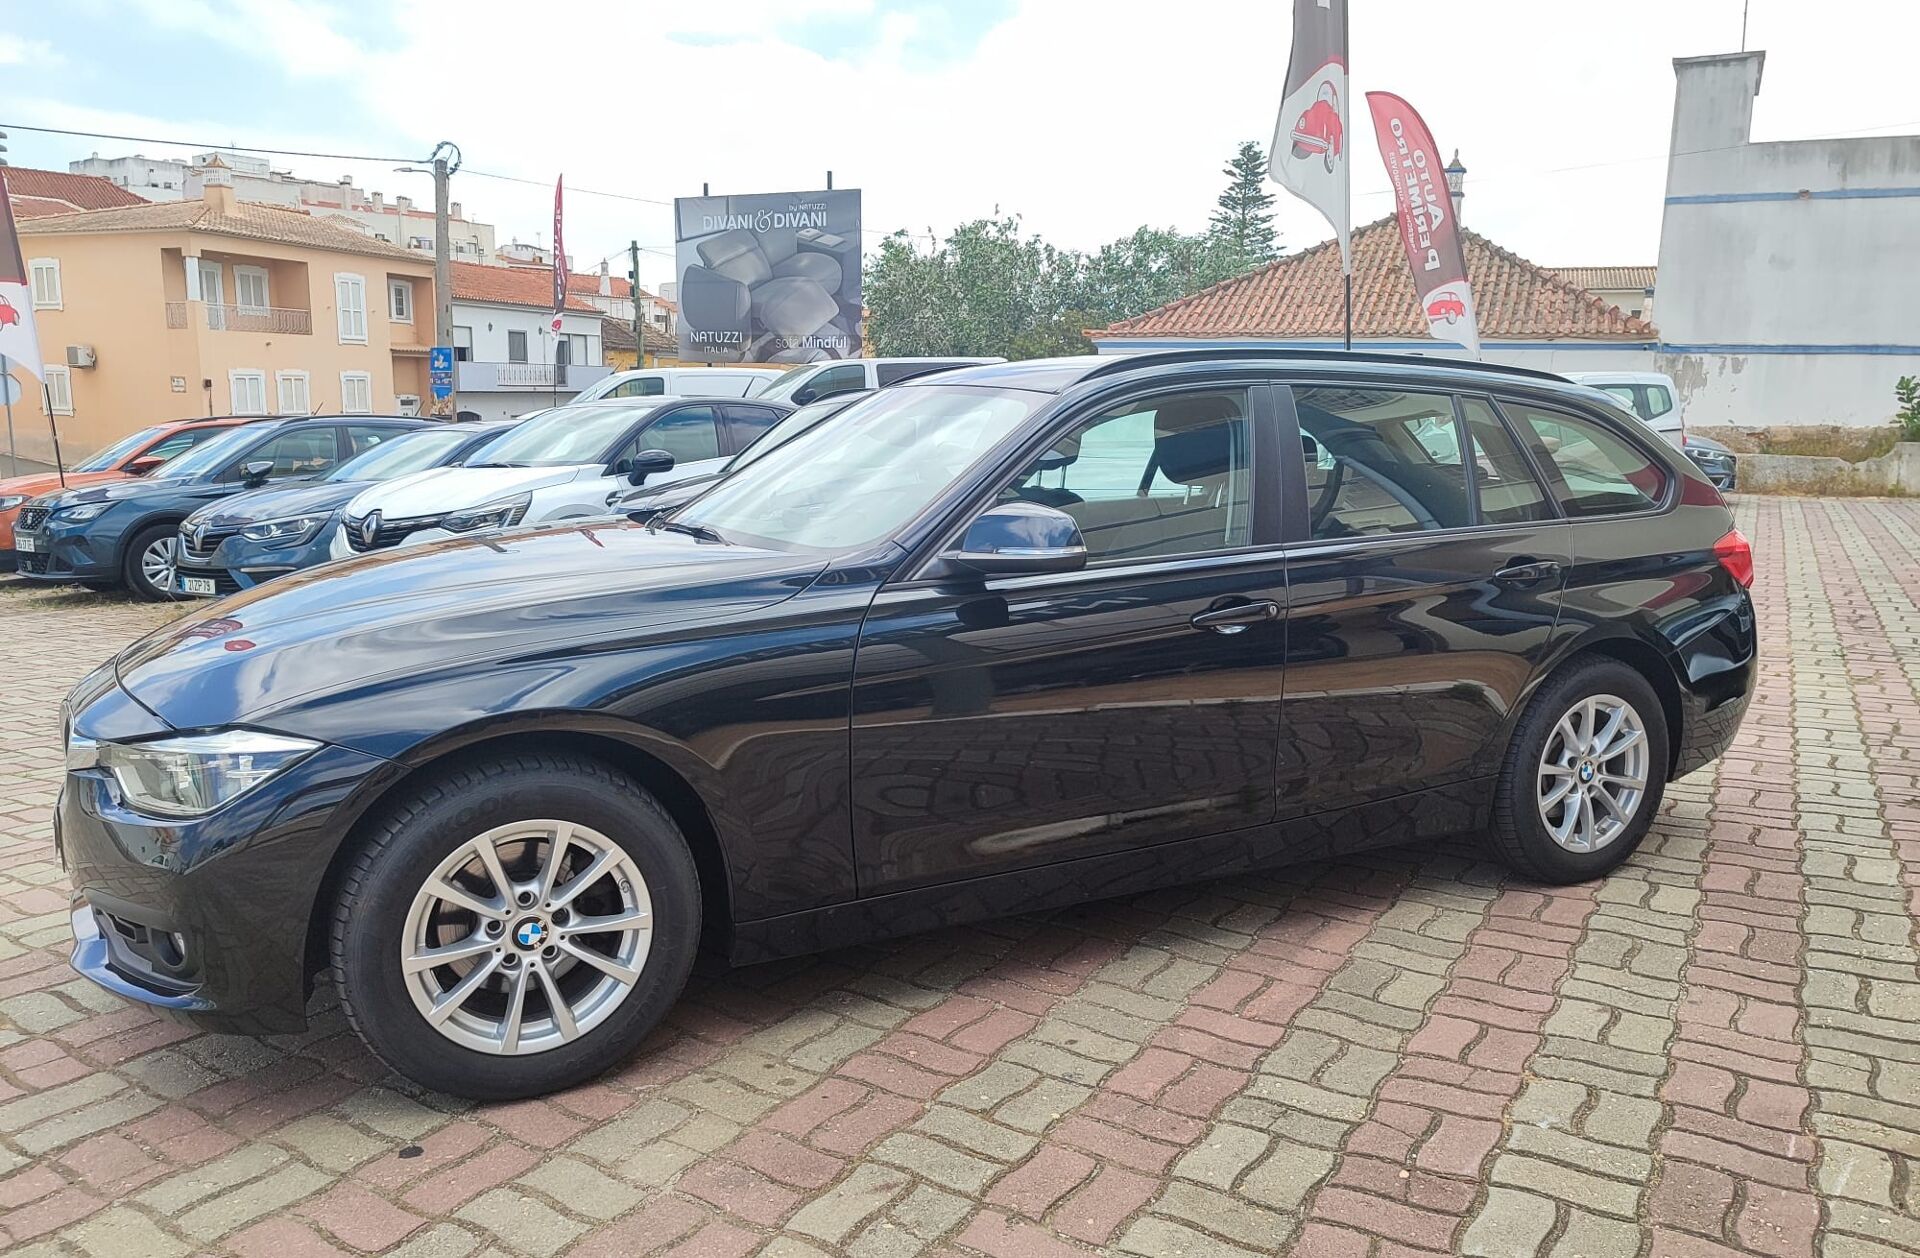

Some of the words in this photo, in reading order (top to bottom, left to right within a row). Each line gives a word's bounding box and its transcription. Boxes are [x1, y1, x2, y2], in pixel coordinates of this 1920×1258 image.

[690, 331, 743, 343] NATUZZI
[775, 337, 799, 349] sofa
[802, 335, 847, 349] Mindful
[704, 346, 729, 354] ITALIA
